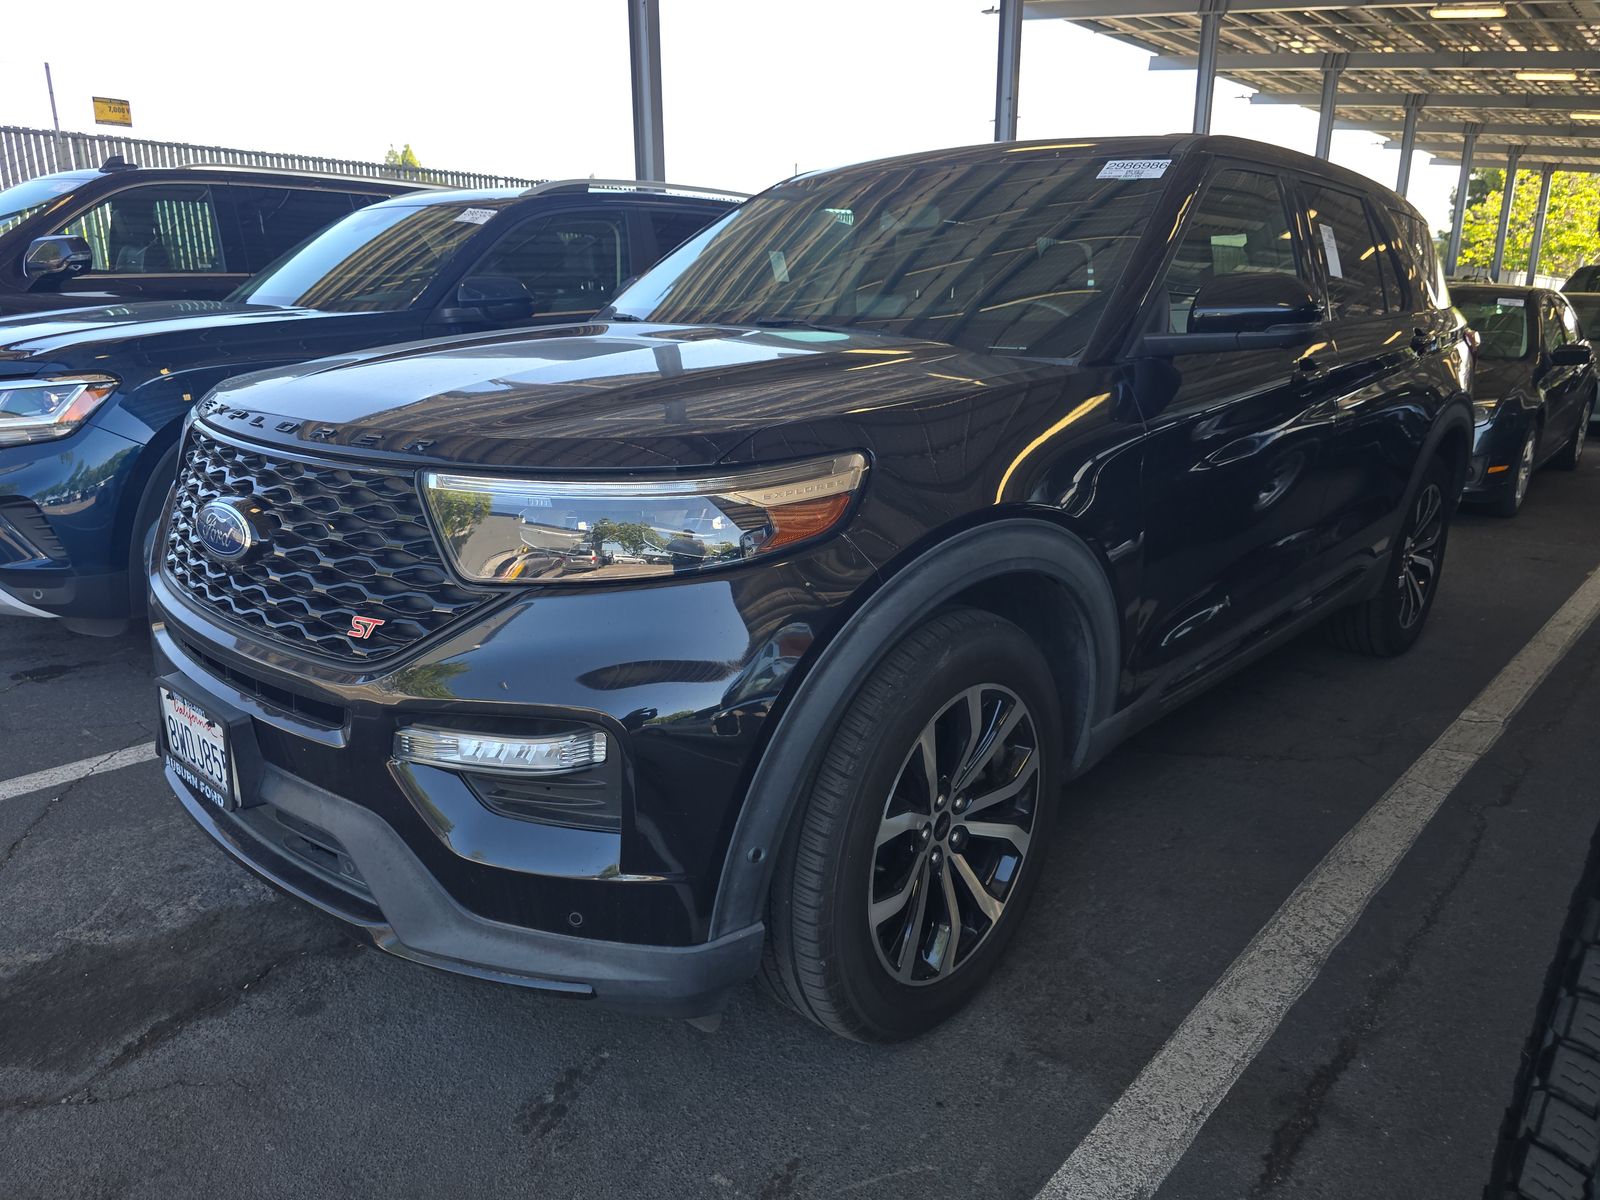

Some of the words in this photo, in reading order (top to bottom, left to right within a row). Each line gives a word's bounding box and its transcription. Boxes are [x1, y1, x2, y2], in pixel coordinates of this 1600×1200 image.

[1106, 162, 1169, 170] 2986986
[763, 481, 844, 500] EXPLORER
[202, 512, 234, 547] Ford
[347, 615, 385, 639] ST
[164, 755, 199, 789] AUBURN
[199, 782, 225, 808] FORD
